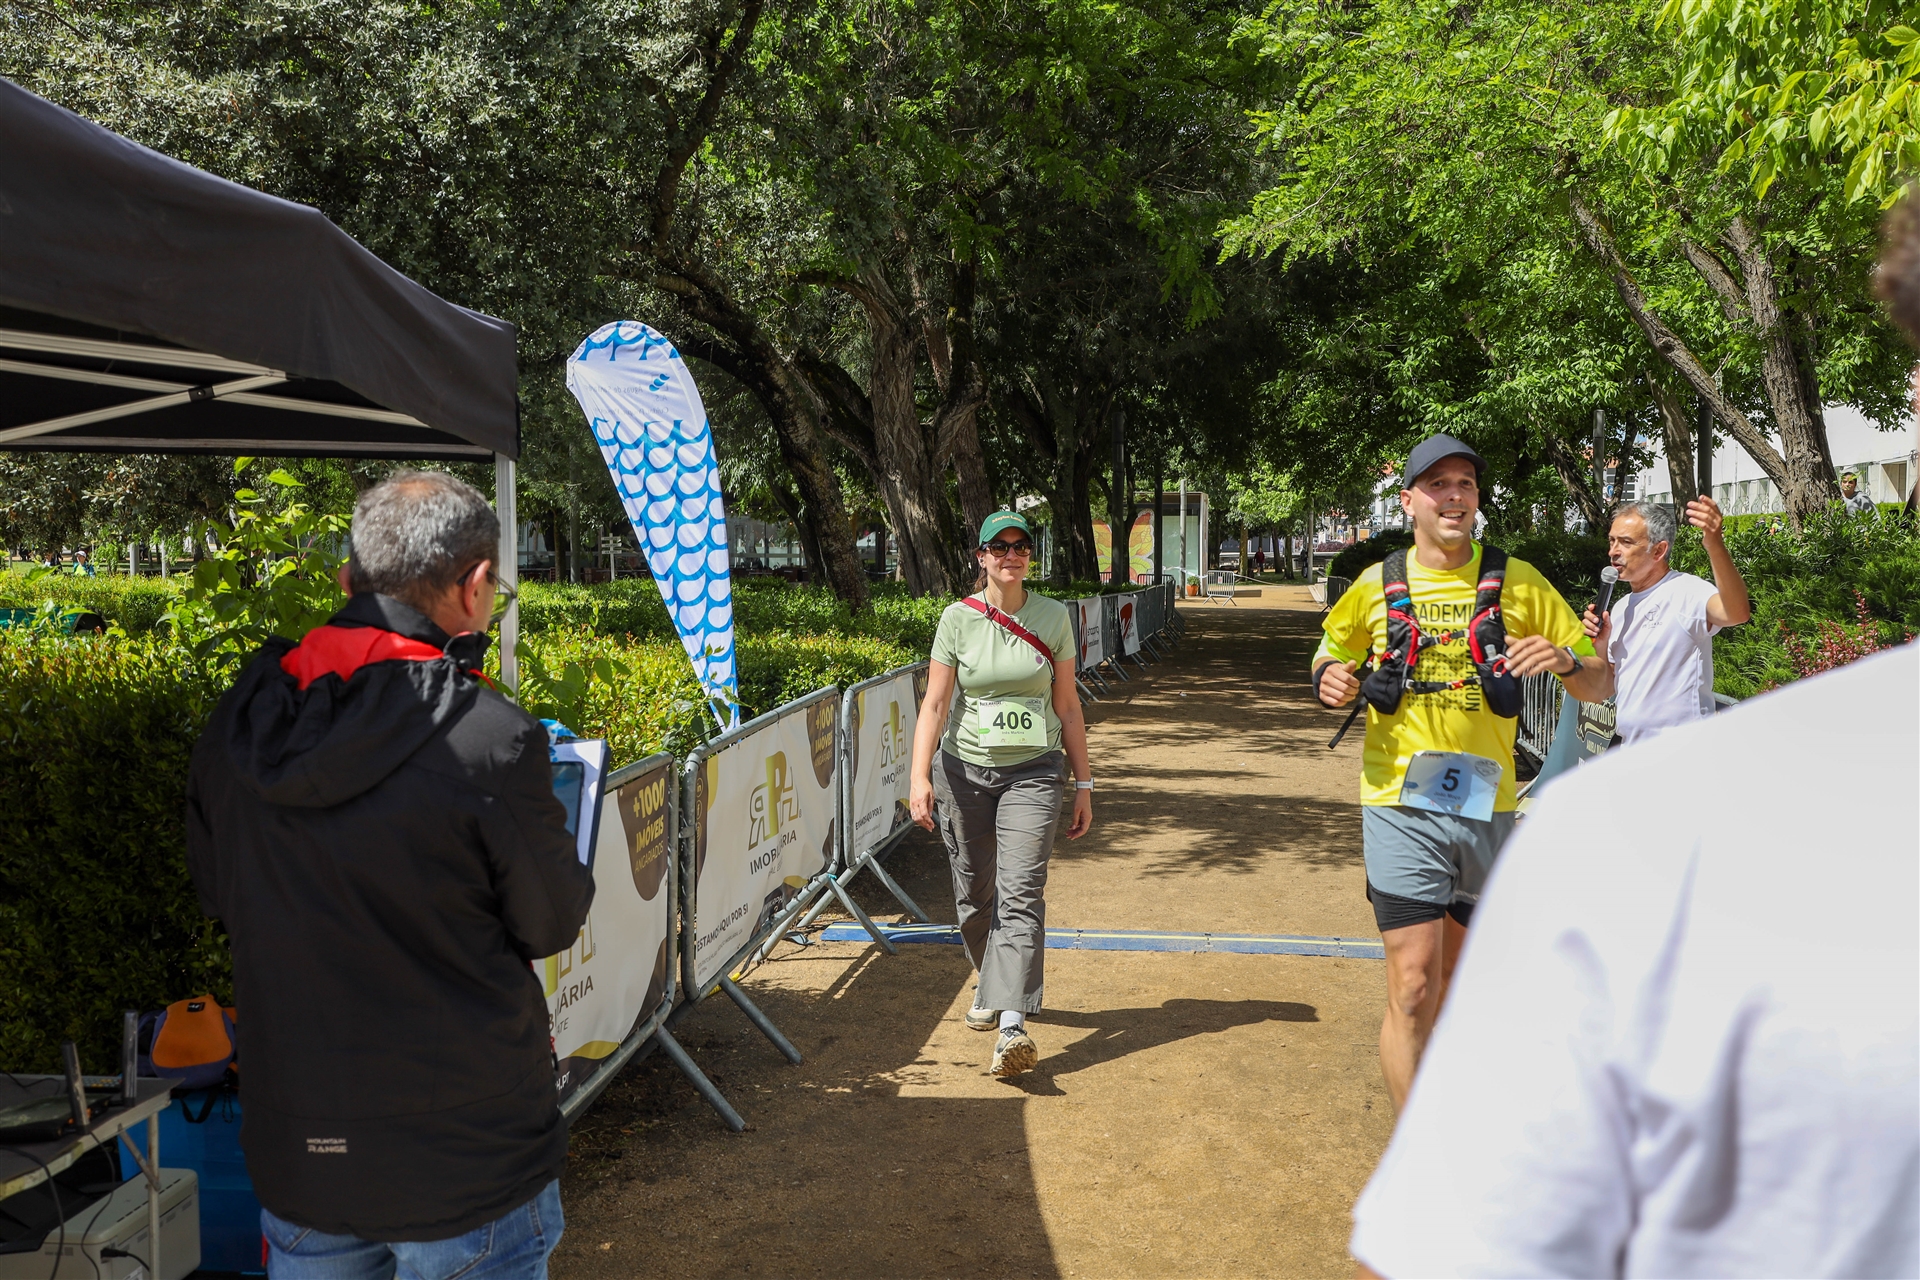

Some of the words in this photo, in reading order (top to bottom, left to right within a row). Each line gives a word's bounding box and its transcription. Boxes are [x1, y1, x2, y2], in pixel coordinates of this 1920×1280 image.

[1412, 603, 1474, 623] ADEMI
[992, 711, 1033, 730] 406
[1441, 767, 1461, 792] 5
[633, 777, 665, 818] +1000
[636, 814, 664, 853] IMÓVEIS
[308, 1145, 348, 1153] RANGE
